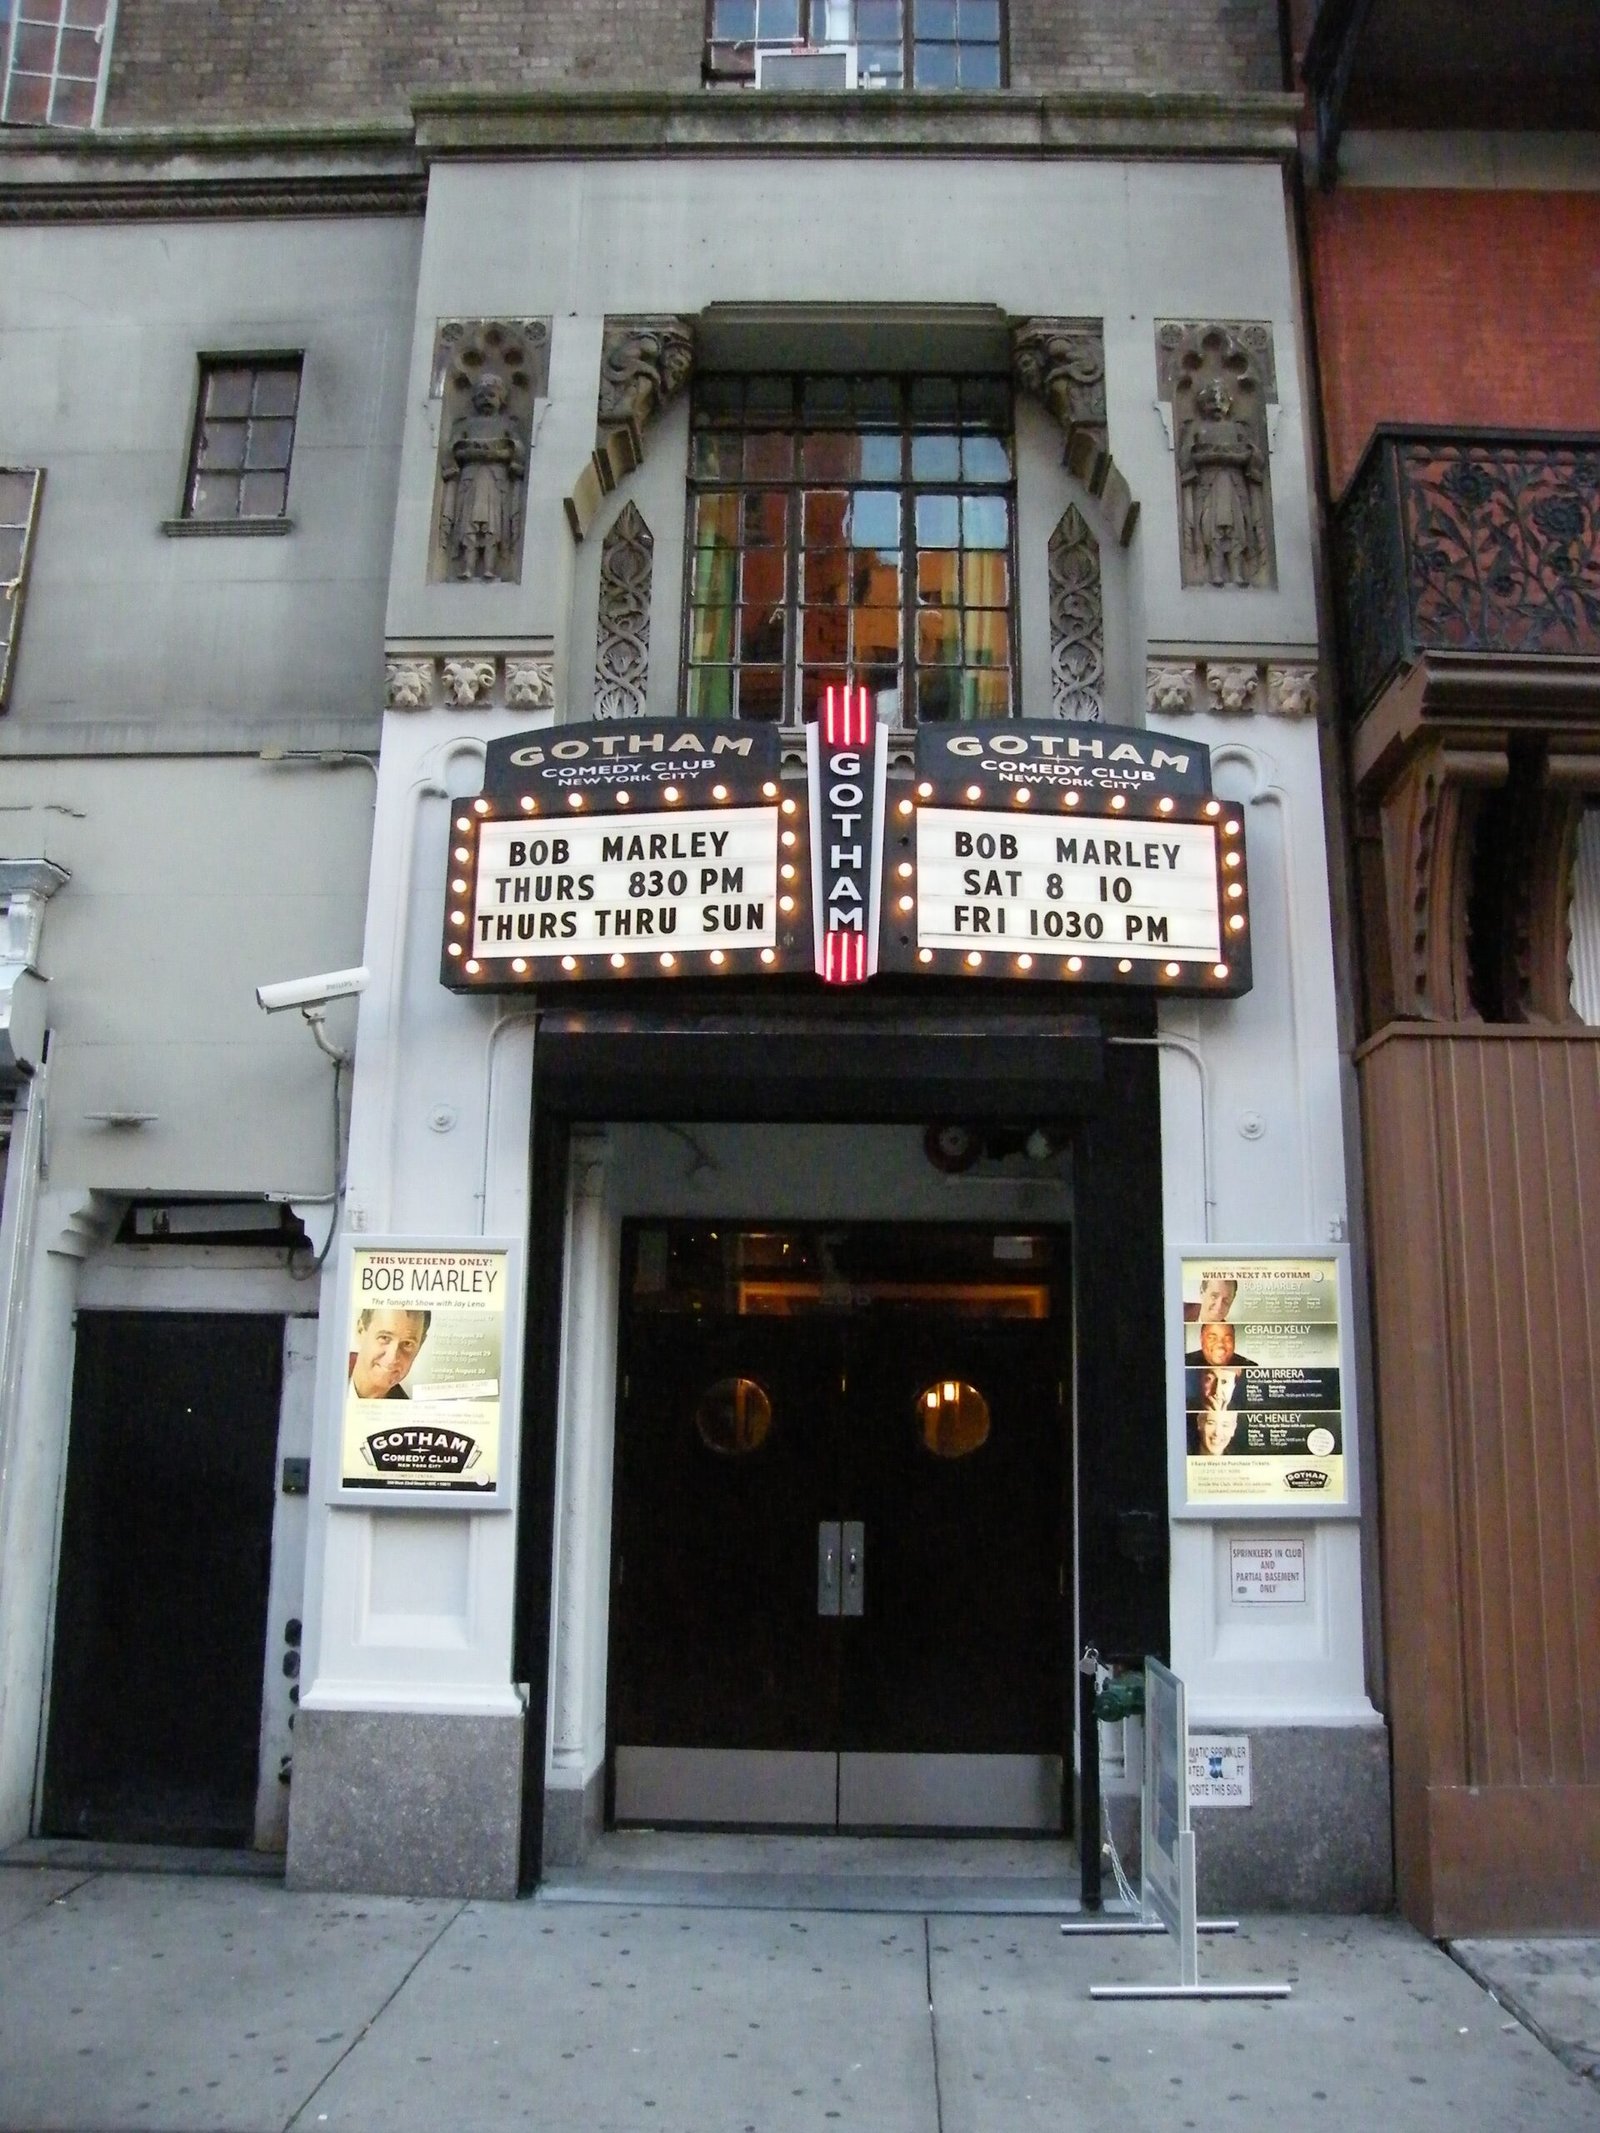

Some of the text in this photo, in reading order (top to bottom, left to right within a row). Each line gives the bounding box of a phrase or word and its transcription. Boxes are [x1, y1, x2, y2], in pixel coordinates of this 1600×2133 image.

[510, 733, 753, 766] GOTHAM
[946, 735, 1189, 774] GOTHAM
[542, 759, 716, 778] COMEDY CLUB
[981, 760, 1156, 781] COMEDY CLUB
[558, 772, 700, 786] NEW YORK CITY
[999, 773, 1142, 790] NEW YORK CITY
[509, 831, 729, 867] BOB MARLEY
[828, 752, 864, 931] GOTHAM
[954, 831, 1181, 869] BOB MARLEY
[495, 867, 744, 903] THURS 830 PM
[963, 869, 1132, 903] SAT 8 10
[478, 903, 764, 941] THURS THRU SUN
[954, 905, 1168, 943] FRI 1030 PM
[370, 1256, 493, 1266] THIS WEEKEND ONLY!
[362, 1268, 498, 1292] BOB MARLEY
[386, 1298, 413, 1307] Tonight
[454, 1300, 466, 1309] Jay
[467, 1300, 485, 1308] Leno
[1244, 1325, 1311, 1335] GERALD KELLY
[1245, 1369, 1305, 1379] DOM IRRERA
[1247, 1414, 1301, 1423] VIC HENLEY
[372, 1432, 468, 1453] GOTHAM
[382, 1453, 459, 1464] COMEDY CLUB
[1233, 1548, 1302, 1558] SPRINKLERS IN CLUB
[1261, 1560, 1275, 1569] AND
[1236, 1572, 1299, 1581] PARTIAL BASEMENT
[1260, 1584, 1276, 1593] ONLY
[1237, 1765, 1244, 1776] FT
[1189, 1784, 1242, 1796] OSITE THIS SIGN
